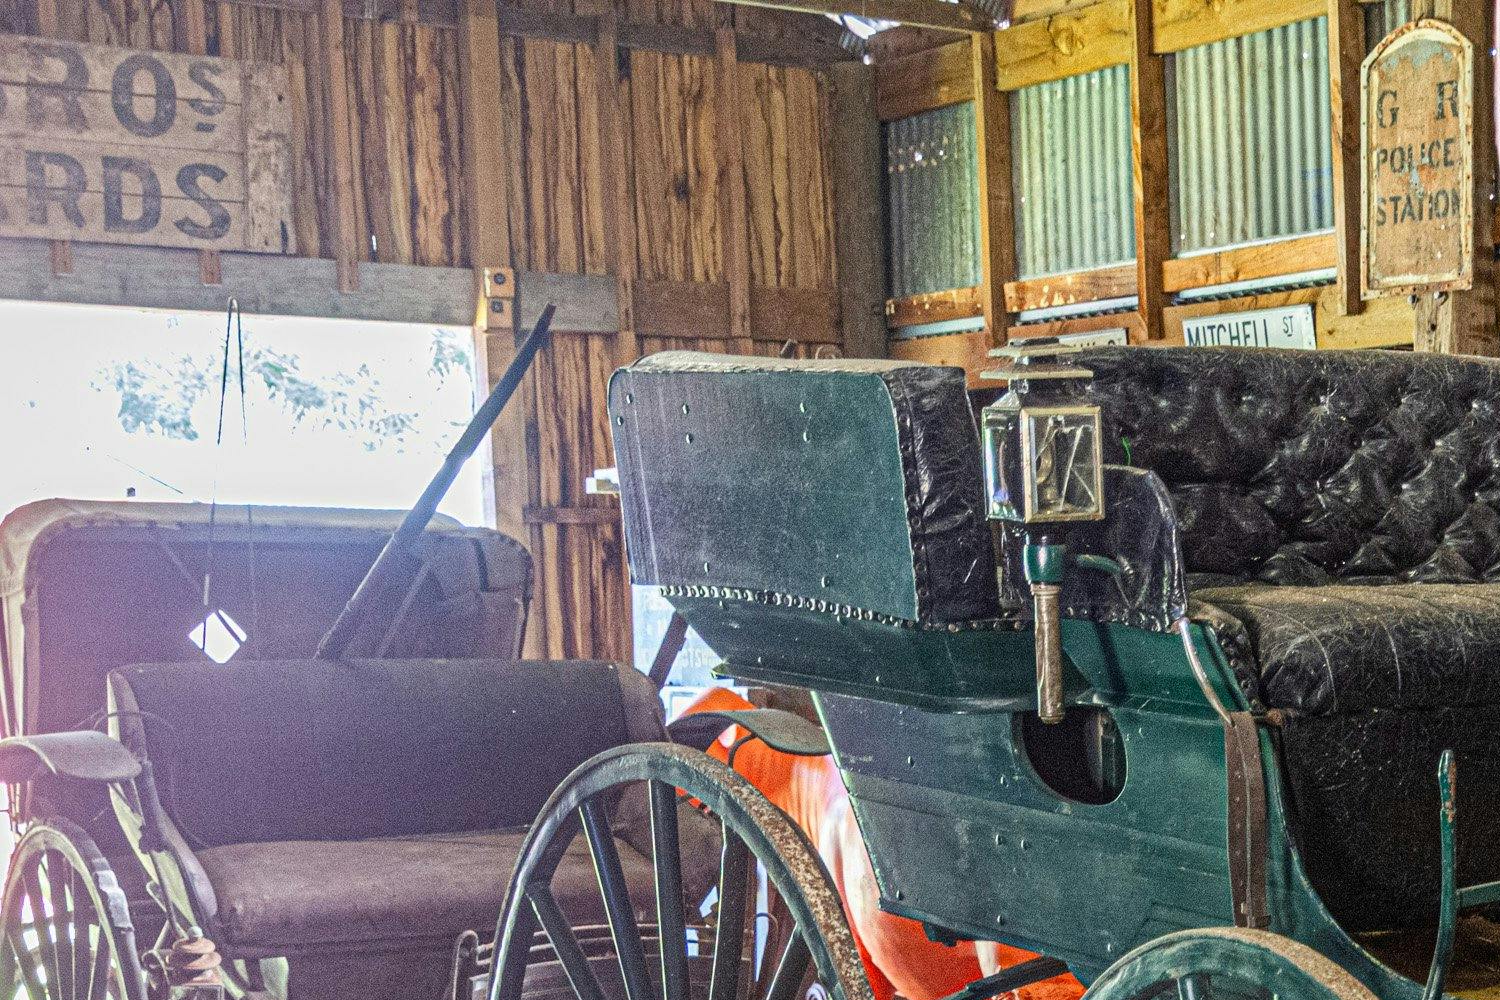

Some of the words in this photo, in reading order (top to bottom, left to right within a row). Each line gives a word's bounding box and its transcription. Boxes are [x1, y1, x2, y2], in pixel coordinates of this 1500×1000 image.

[0, 43, 226, 138] ROS
[1376, 90, 1399, 129] G
[1434, 80, 1459, 120] R
[1375, 138, 1455, 176] POLICE
[0, 148, 232, 241] RDS
[1376, 187, 1461, 227] STATION
[1186, 318, 1269, 347] MITCHELL
[1282, 315, 1294, 337] ST
